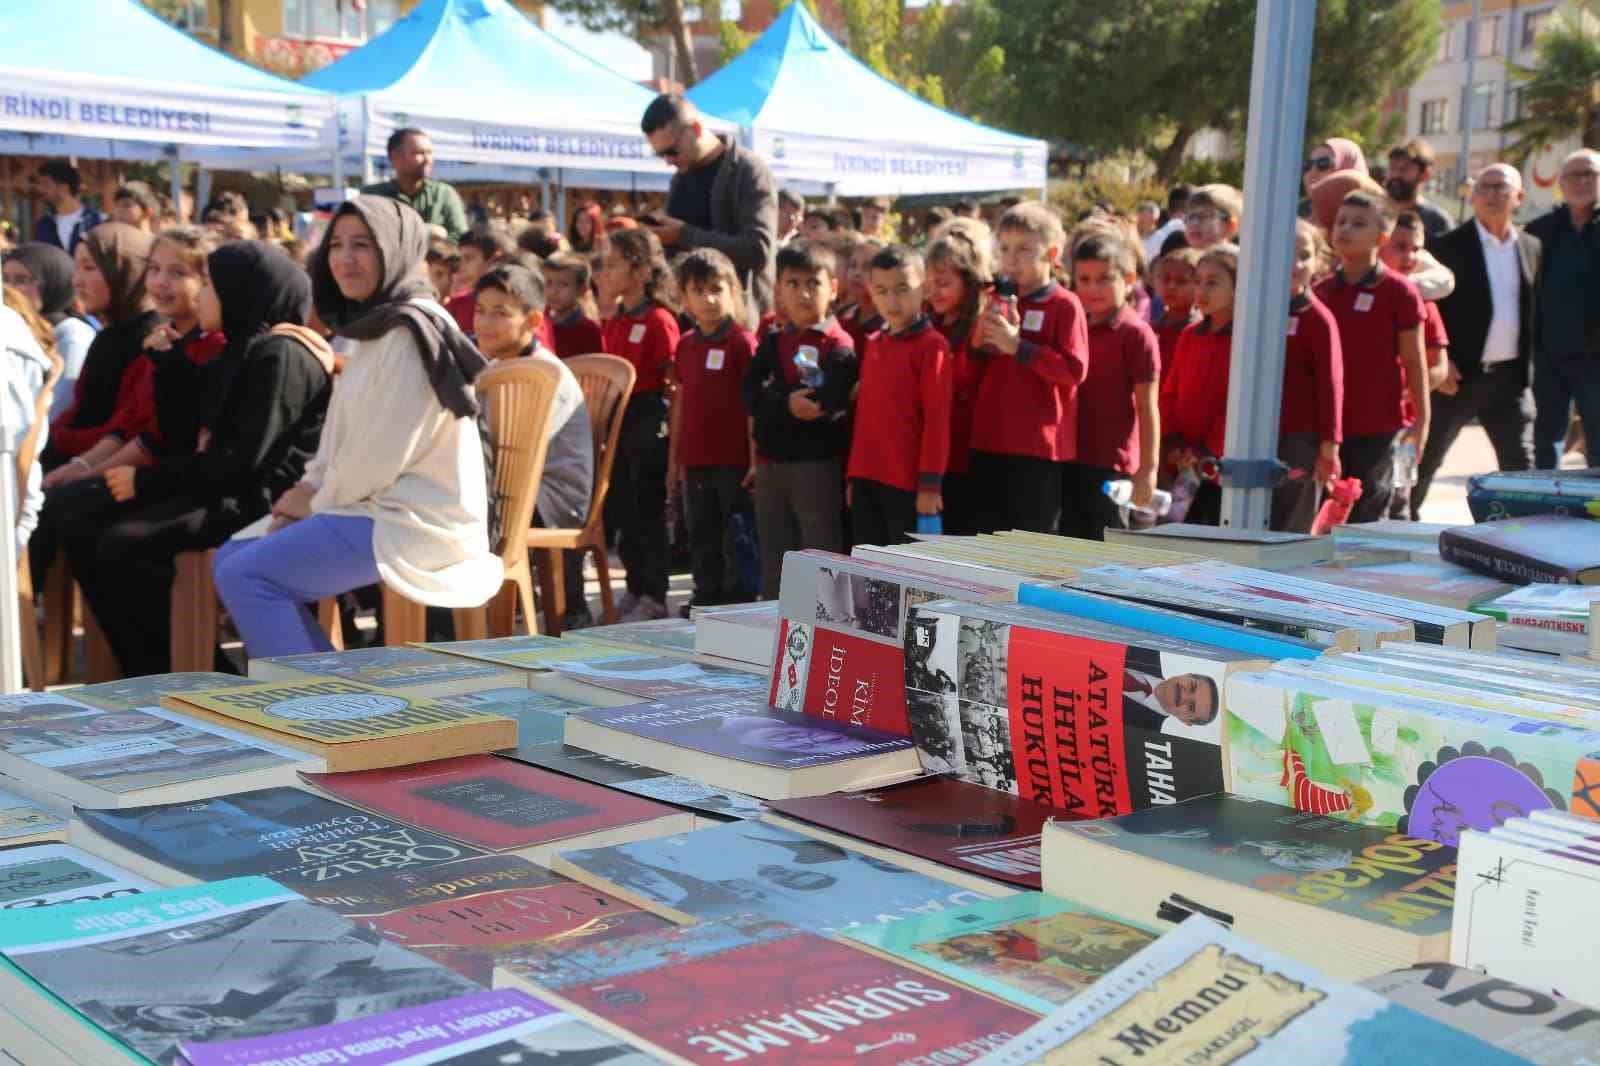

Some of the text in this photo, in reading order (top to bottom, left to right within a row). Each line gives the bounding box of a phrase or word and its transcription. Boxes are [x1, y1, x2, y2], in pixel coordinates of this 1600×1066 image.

[2, 93, 71, 120] RİNDİ
[849, 677, 869, 727] KİM
[1087, 660, 1120, 818] ATATÜRK
[1144, 740, 1177, 807] TAHA
[297, 828, 415, 866] Atay
[300, 842, 462, 884] Oğuz
[688, 978, 950, 1060] SURNÂME
[1110, 973, 1228, 1056] Memnu
